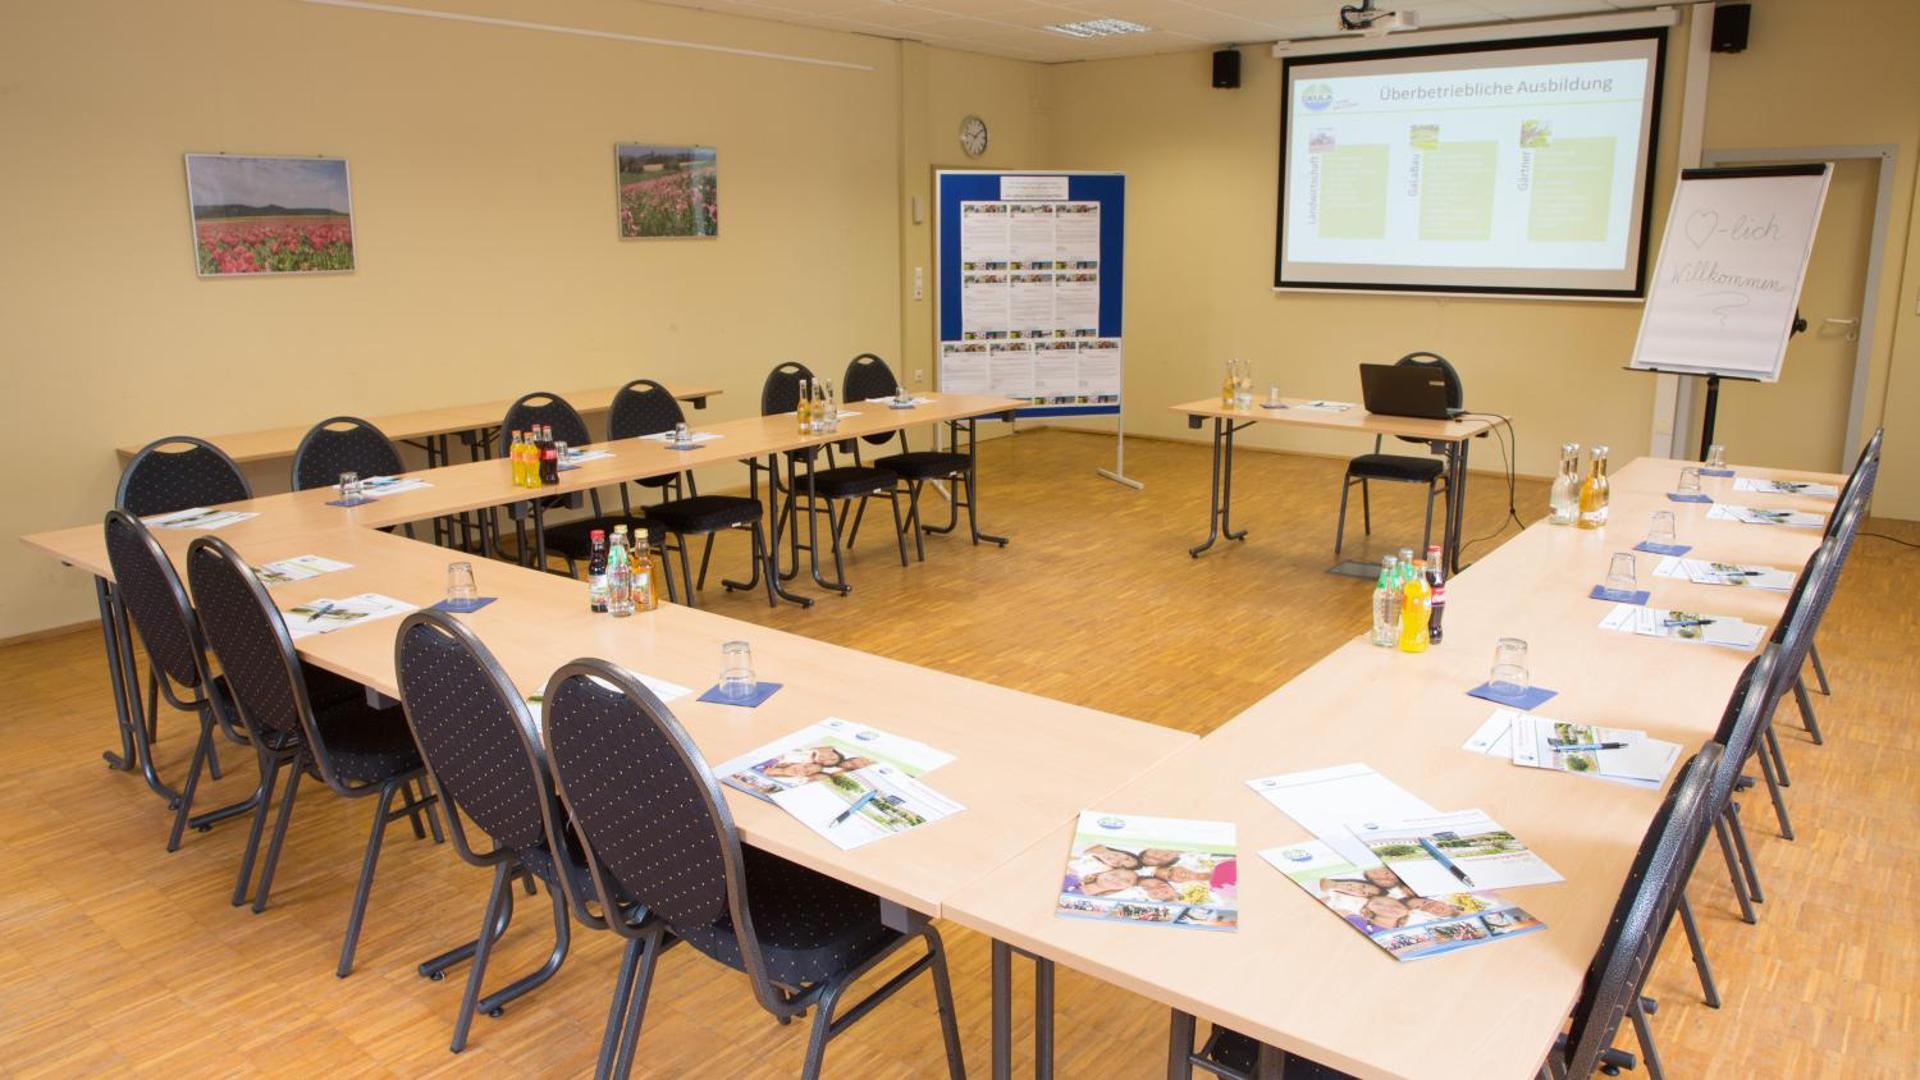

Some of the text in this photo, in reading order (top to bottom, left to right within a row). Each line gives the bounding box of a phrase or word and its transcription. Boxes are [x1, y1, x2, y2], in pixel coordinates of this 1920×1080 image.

[1379, 76, 1614, 102] Überbetriebliche Ausbildung
[1516, 151, 1532, 192] Gärtner
[1671, 261, 1786, 292] Willkommen
